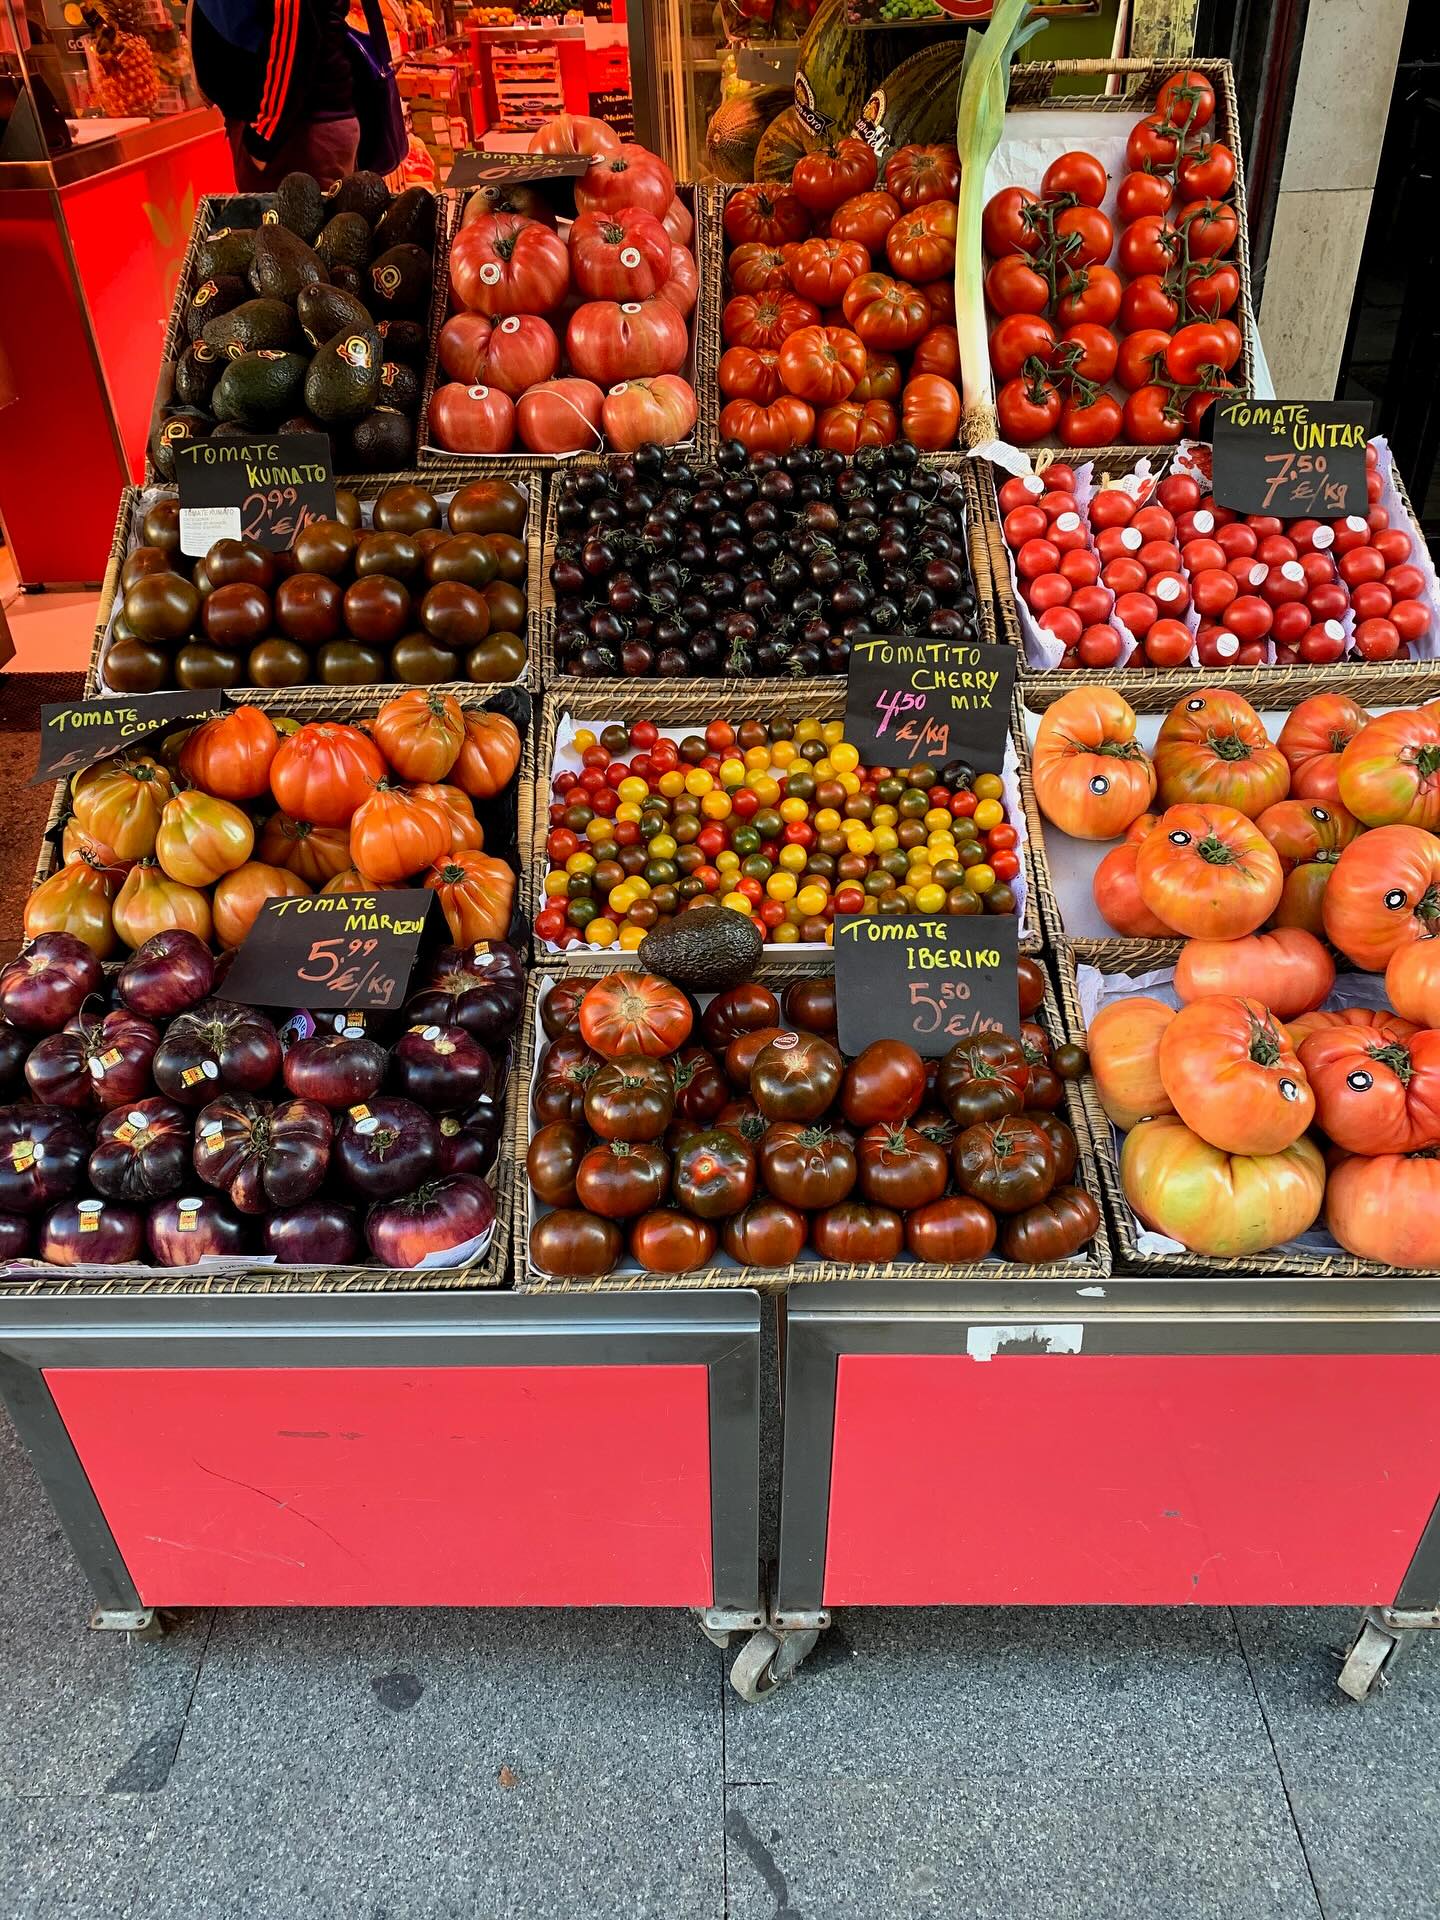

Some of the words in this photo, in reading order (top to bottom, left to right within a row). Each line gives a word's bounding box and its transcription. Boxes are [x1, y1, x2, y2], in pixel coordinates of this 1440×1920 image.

[463, 151, 543, 161] TOMATE
[1221, 402, 1310, 426] TOMATE
[1271, 426, 1286, 435] DE
[1293, 423, 1366, 450] UNTAR
[181, 444, 279, 464] TOMATE
[246, 464, 326, 488] KUMATO
[911, 669, 999, 692] CHERRY
[951, 694, 993, 710] MIX
[48, 708, 138, 732] TOMATE
[269, 897, 376, 916] TOMATE
[841, 919, 947, 941] TOMATE
[907, 947, 1000, 969] IBERIKO
